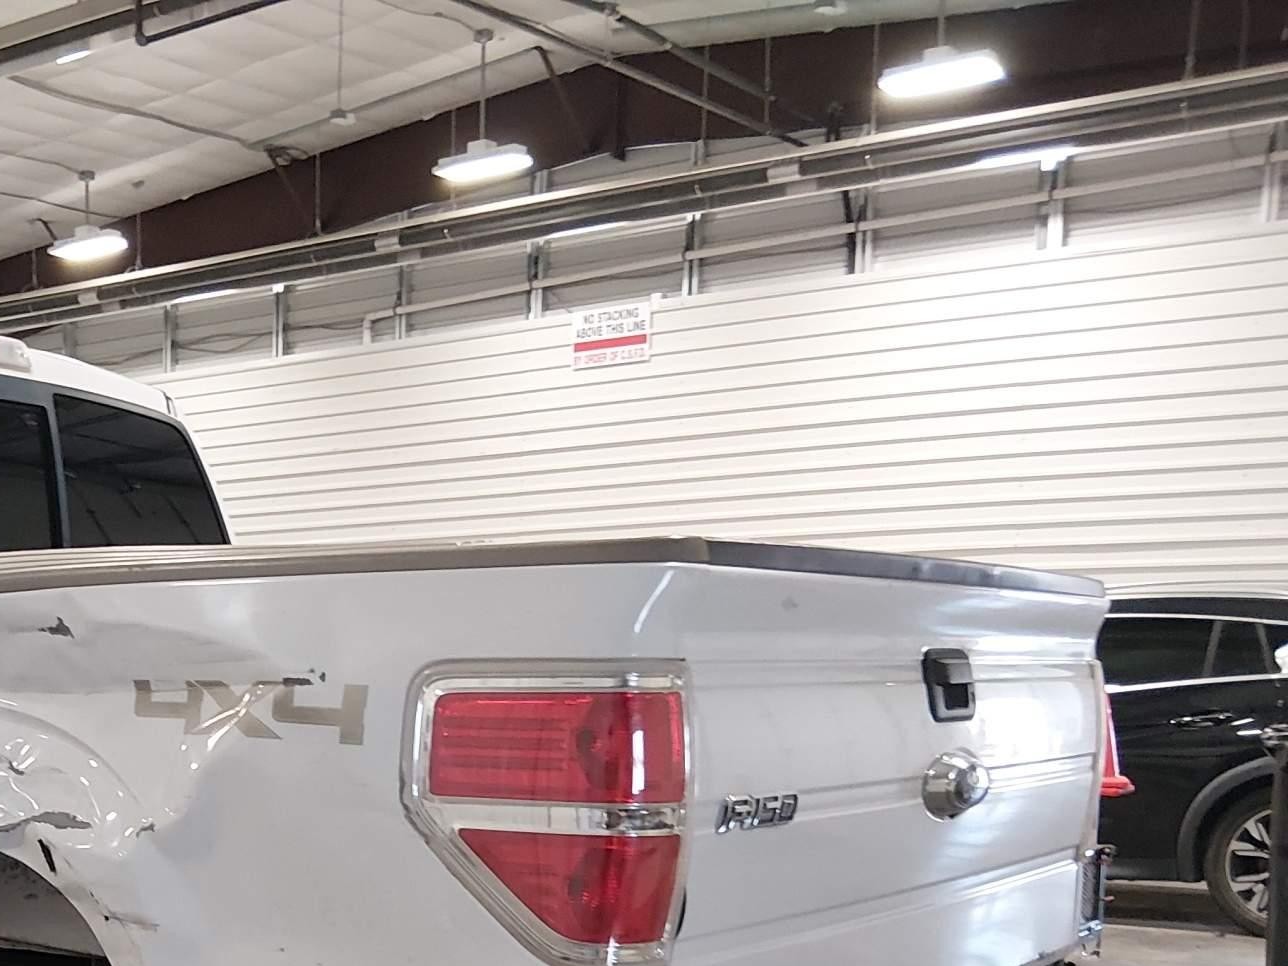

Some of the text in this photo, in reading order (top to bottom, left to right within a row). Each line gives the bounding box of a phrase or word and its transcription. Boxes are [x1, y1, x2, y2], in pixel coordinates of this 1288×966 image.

[583, 307, 639, 324] NO STACKING
[576, 320, 646, 338] ABOVE THIS LINE
